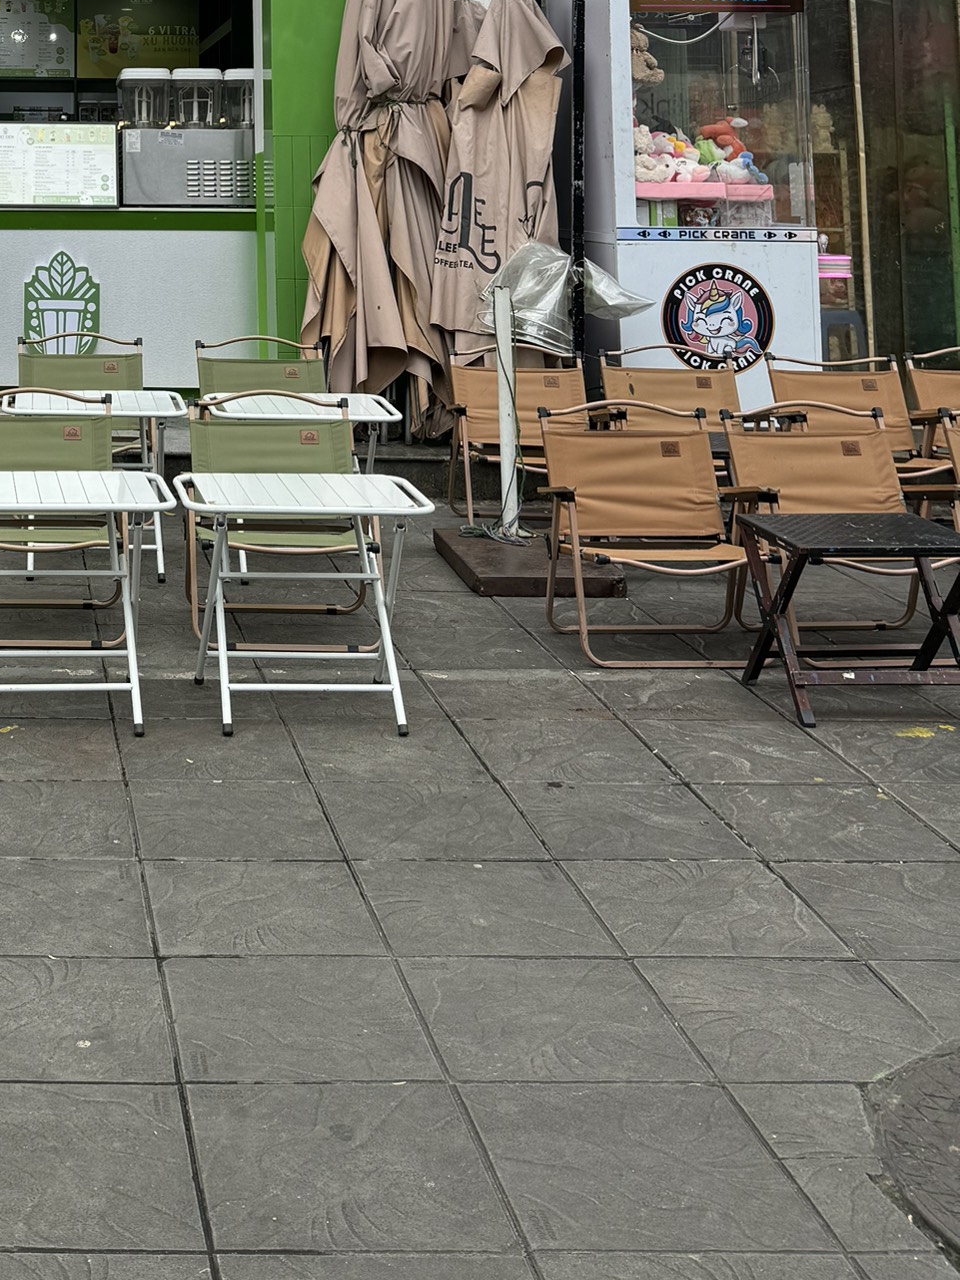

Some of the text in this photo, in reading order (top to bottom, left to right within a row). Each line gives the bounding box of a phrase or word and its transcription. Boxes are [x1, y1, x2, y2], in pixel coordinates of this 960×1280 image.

[148, 26, 155, 35] 6
[142, 37, 158, 47] XU
[679, 230, 708, 239] PICK
[674, 268, 759, 299] PICK CRANE
